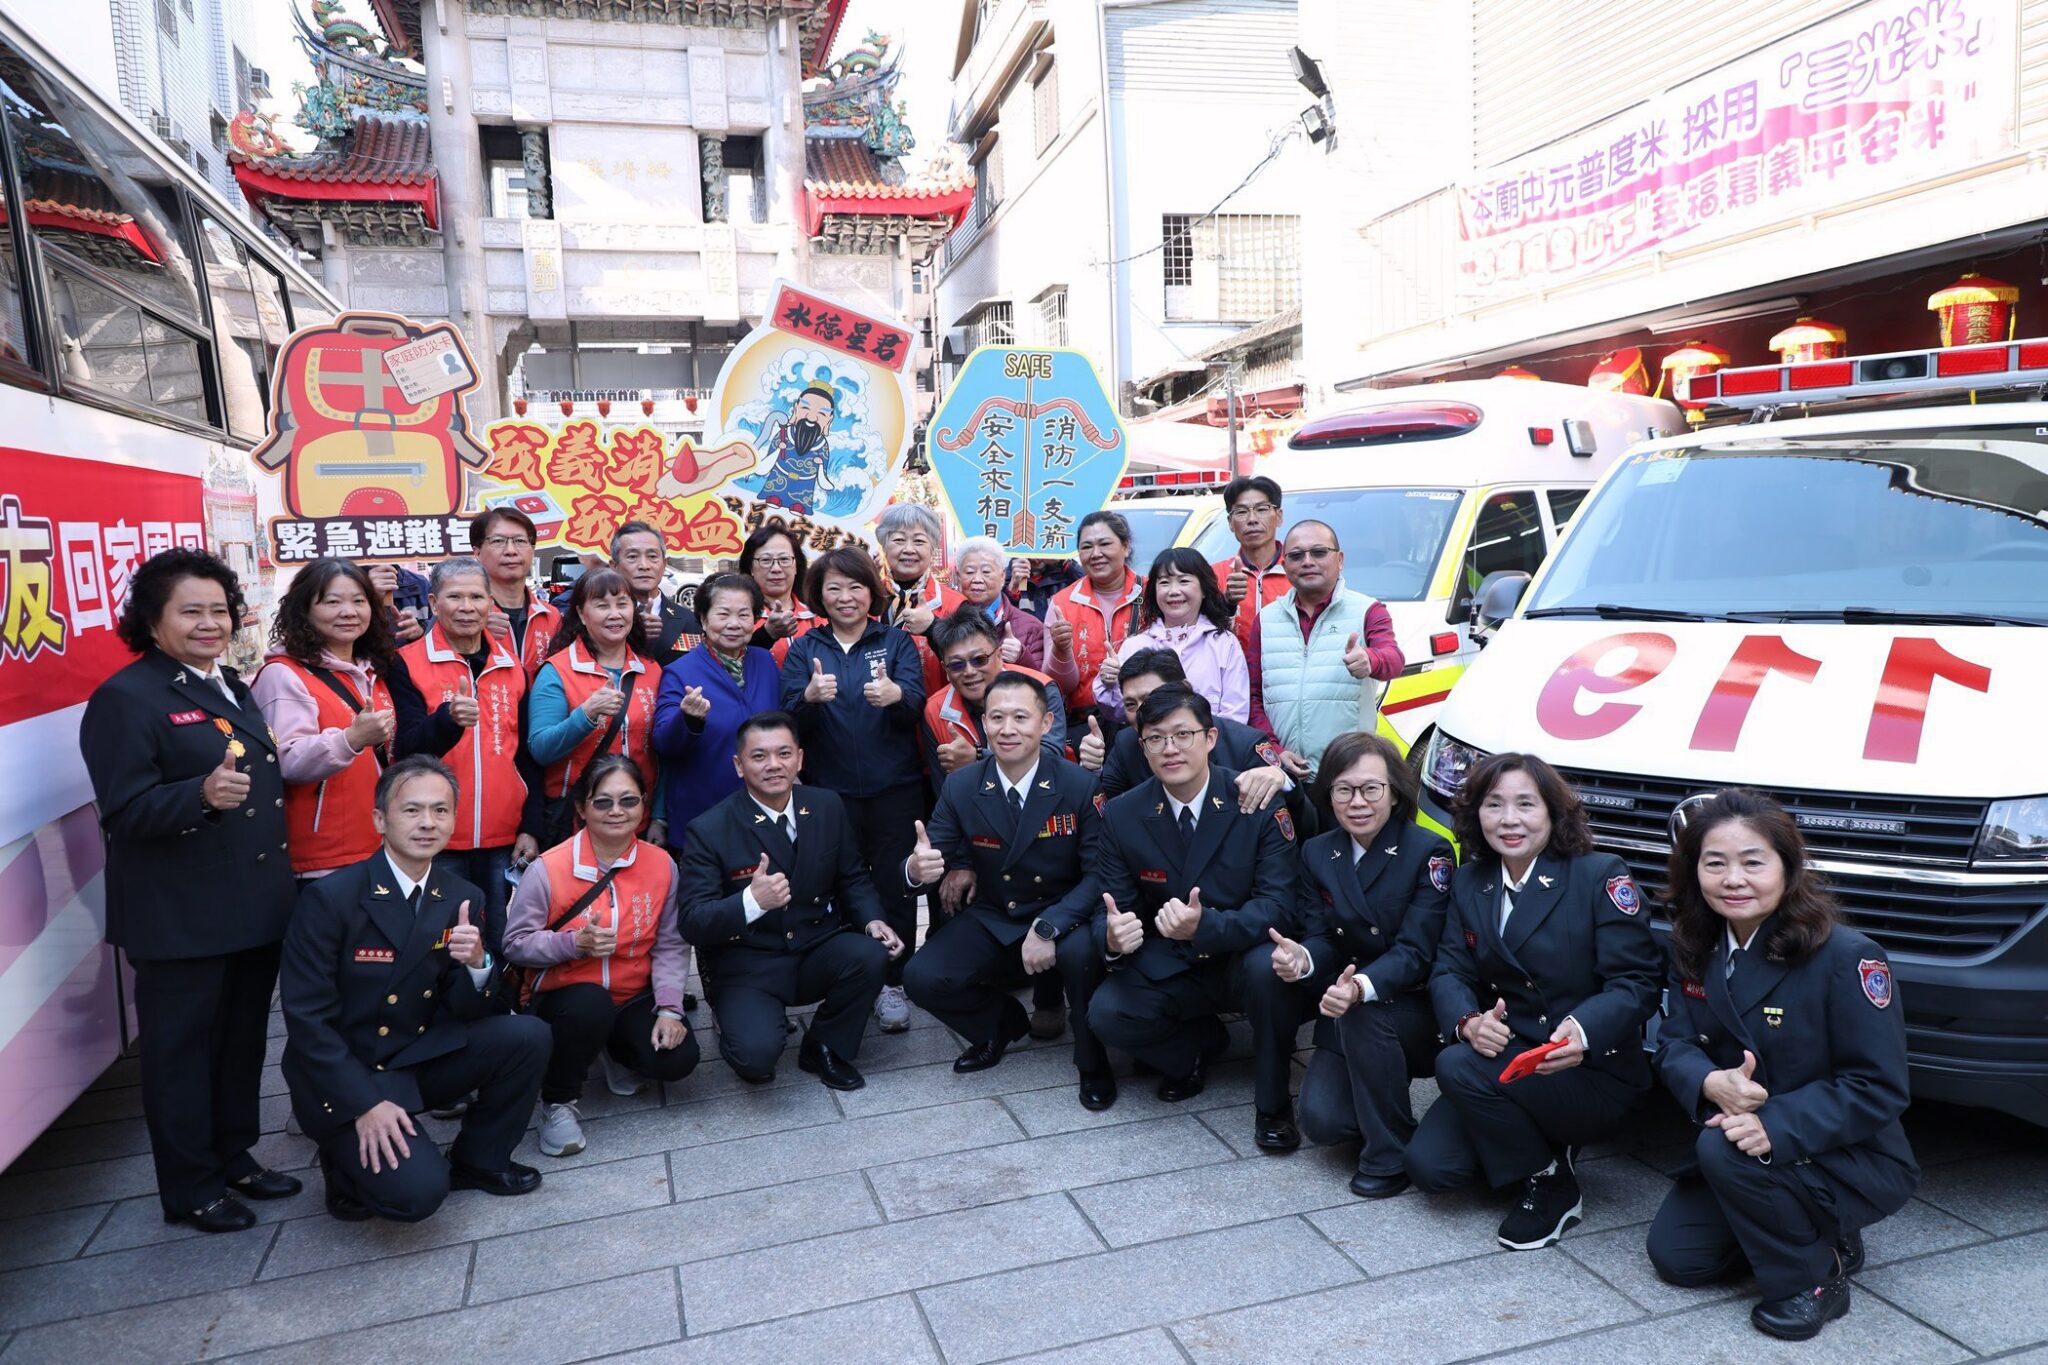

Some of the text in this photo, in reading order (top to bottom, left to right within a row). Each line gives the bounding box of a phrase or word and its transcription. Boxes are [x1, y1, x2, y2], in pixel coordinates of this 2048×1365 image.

[1682, 79, 1759, 156] 採用
[387, 336, 452, 368] 家庭防災卡
[783, 302, 903, 362] 水德星君
[1005, 353, 1052, 378] SAFE
[488, 422, 664, 497] 我義消
[1039, 416, 1077, 551] 消防一支箭
[536, 529, 550, 537] OD
